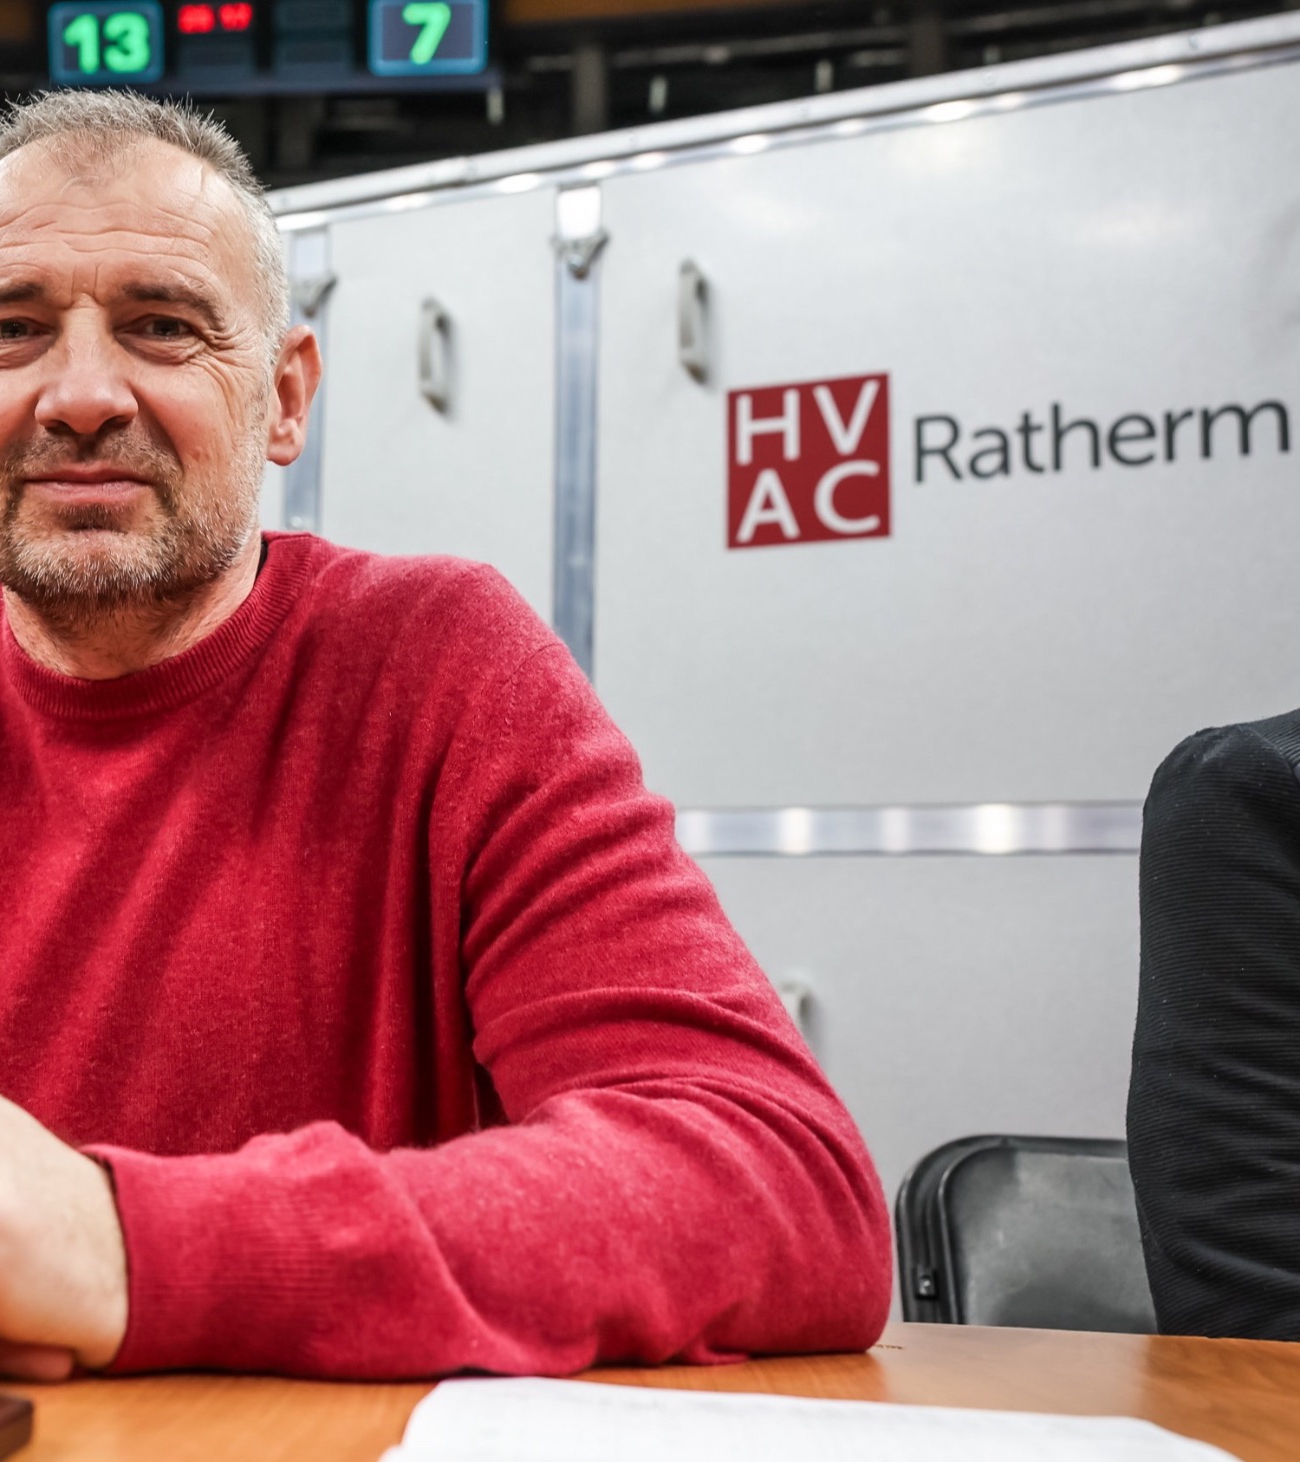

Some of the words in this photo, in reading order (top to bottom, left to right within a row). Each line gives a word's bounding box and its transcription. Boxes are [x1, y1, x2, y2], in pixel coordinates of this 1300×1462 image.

[63, 12, 150, 74] 13
[402, 2, 451, 65] 7
[735, 379, 880, 466] HV
[914, 399, 1291, 484] Ratherm
[735, 460, 880, 543] AC
